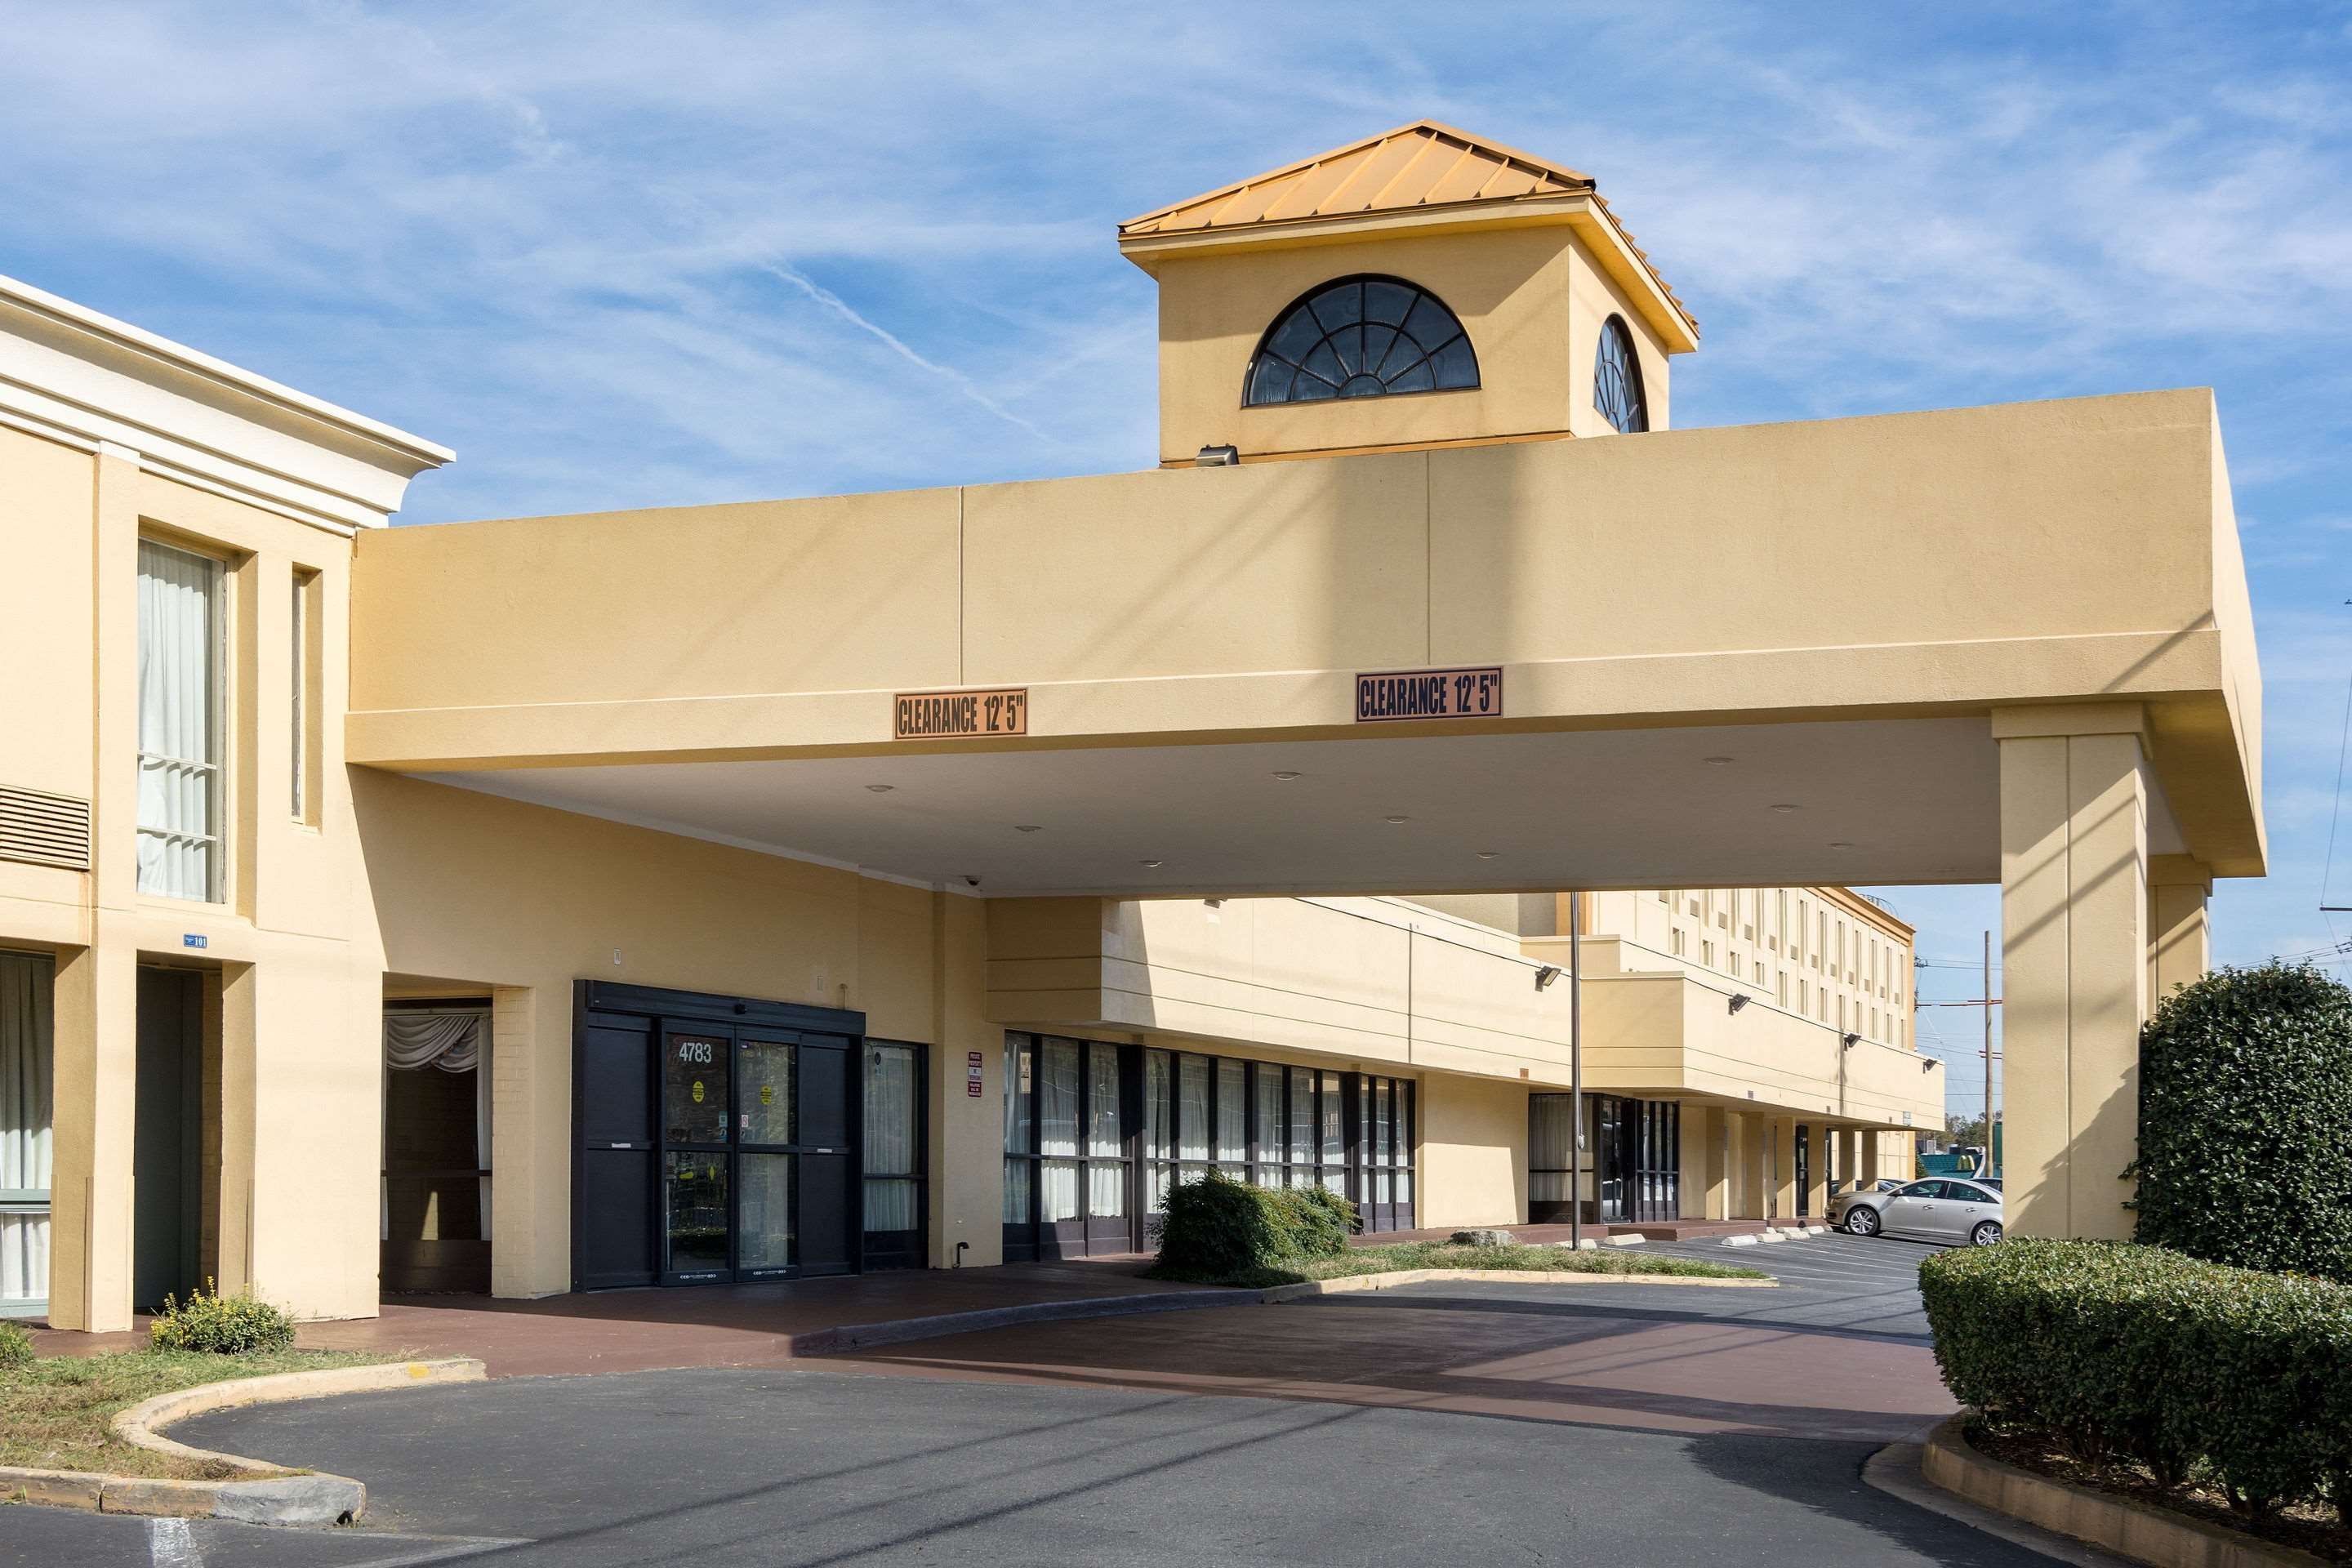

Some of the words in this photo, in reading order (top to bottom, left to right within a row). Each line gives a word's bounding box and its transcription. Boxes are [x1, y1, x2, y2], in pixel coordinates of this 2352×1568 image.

[1360, 676, 1447, 718] CLEARANCE
[1454, 675, 1476, 713] 12'
[898, 697, 978, 735] CLEARANCE
[983, 696, 1004, 732] 12'
[194, 936, 207, 947] 101
[679, 1042, 712, 1063] 4783
